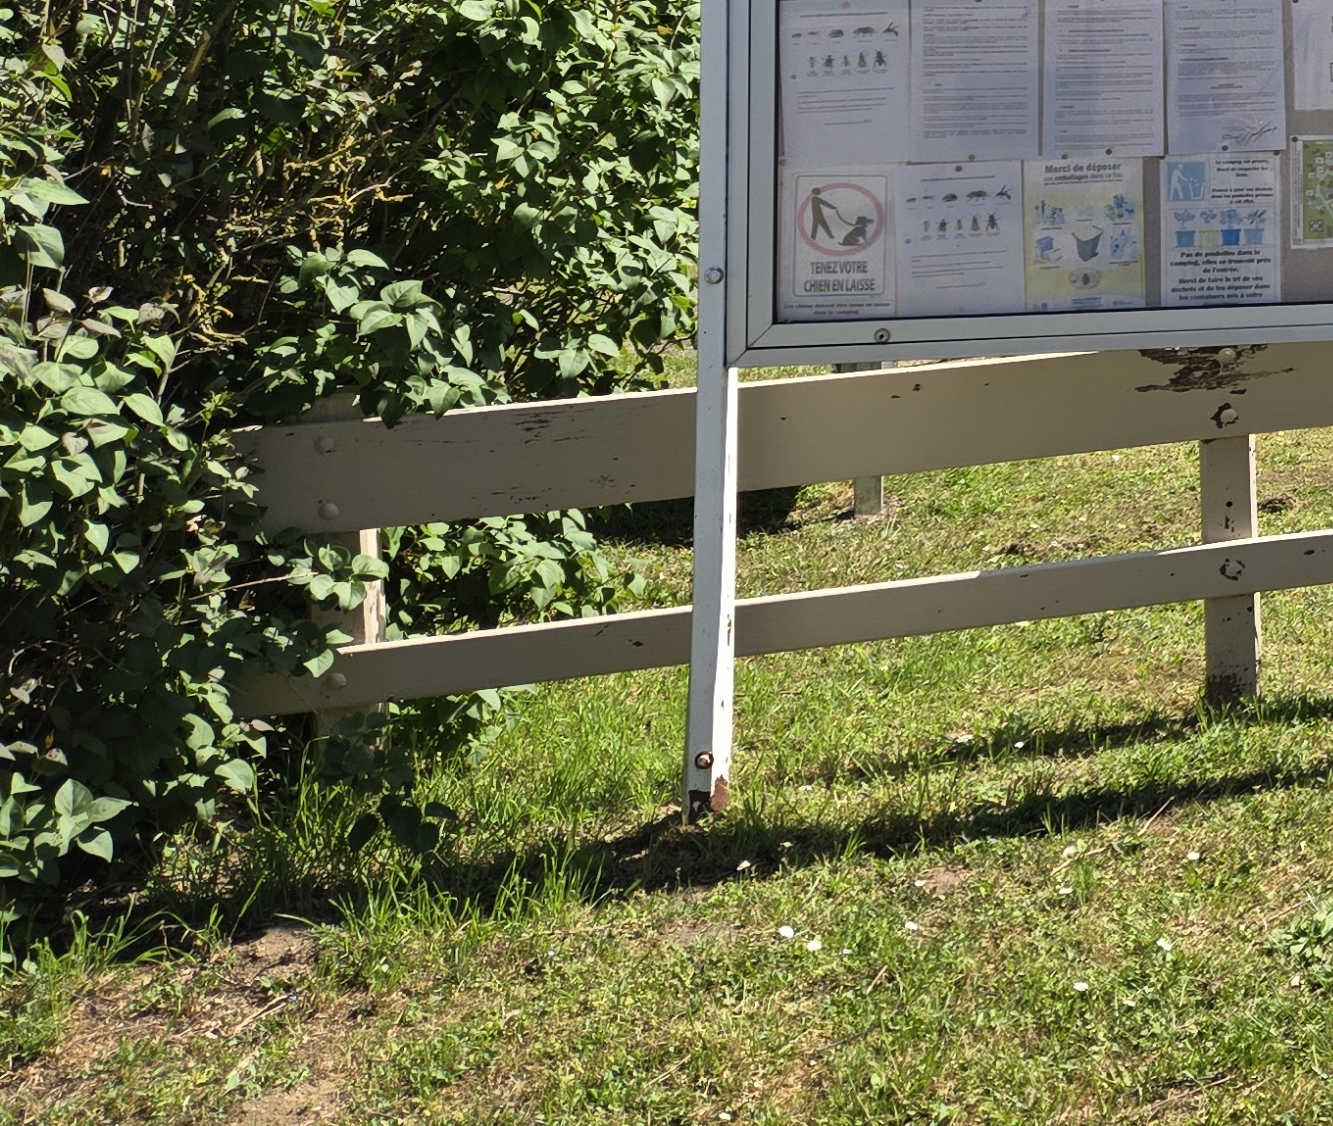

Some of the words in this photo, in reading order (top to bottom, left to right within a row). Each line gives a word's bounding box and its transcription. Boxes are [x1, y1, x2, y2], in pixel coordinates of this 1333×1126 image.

[1045, 165, 1070, 173] Merci
[1073, 164, 1083, 172] de
[1086, 163, 1122, 173] déposer
[810, 261, 838, 274] TENEZ
[839, 261, 868, 274] VOTRE
[804, 279, 830, 292] CHIEN
[832, 279, 843, 292] EN
[846, 278, 875, 291] LAISSE
